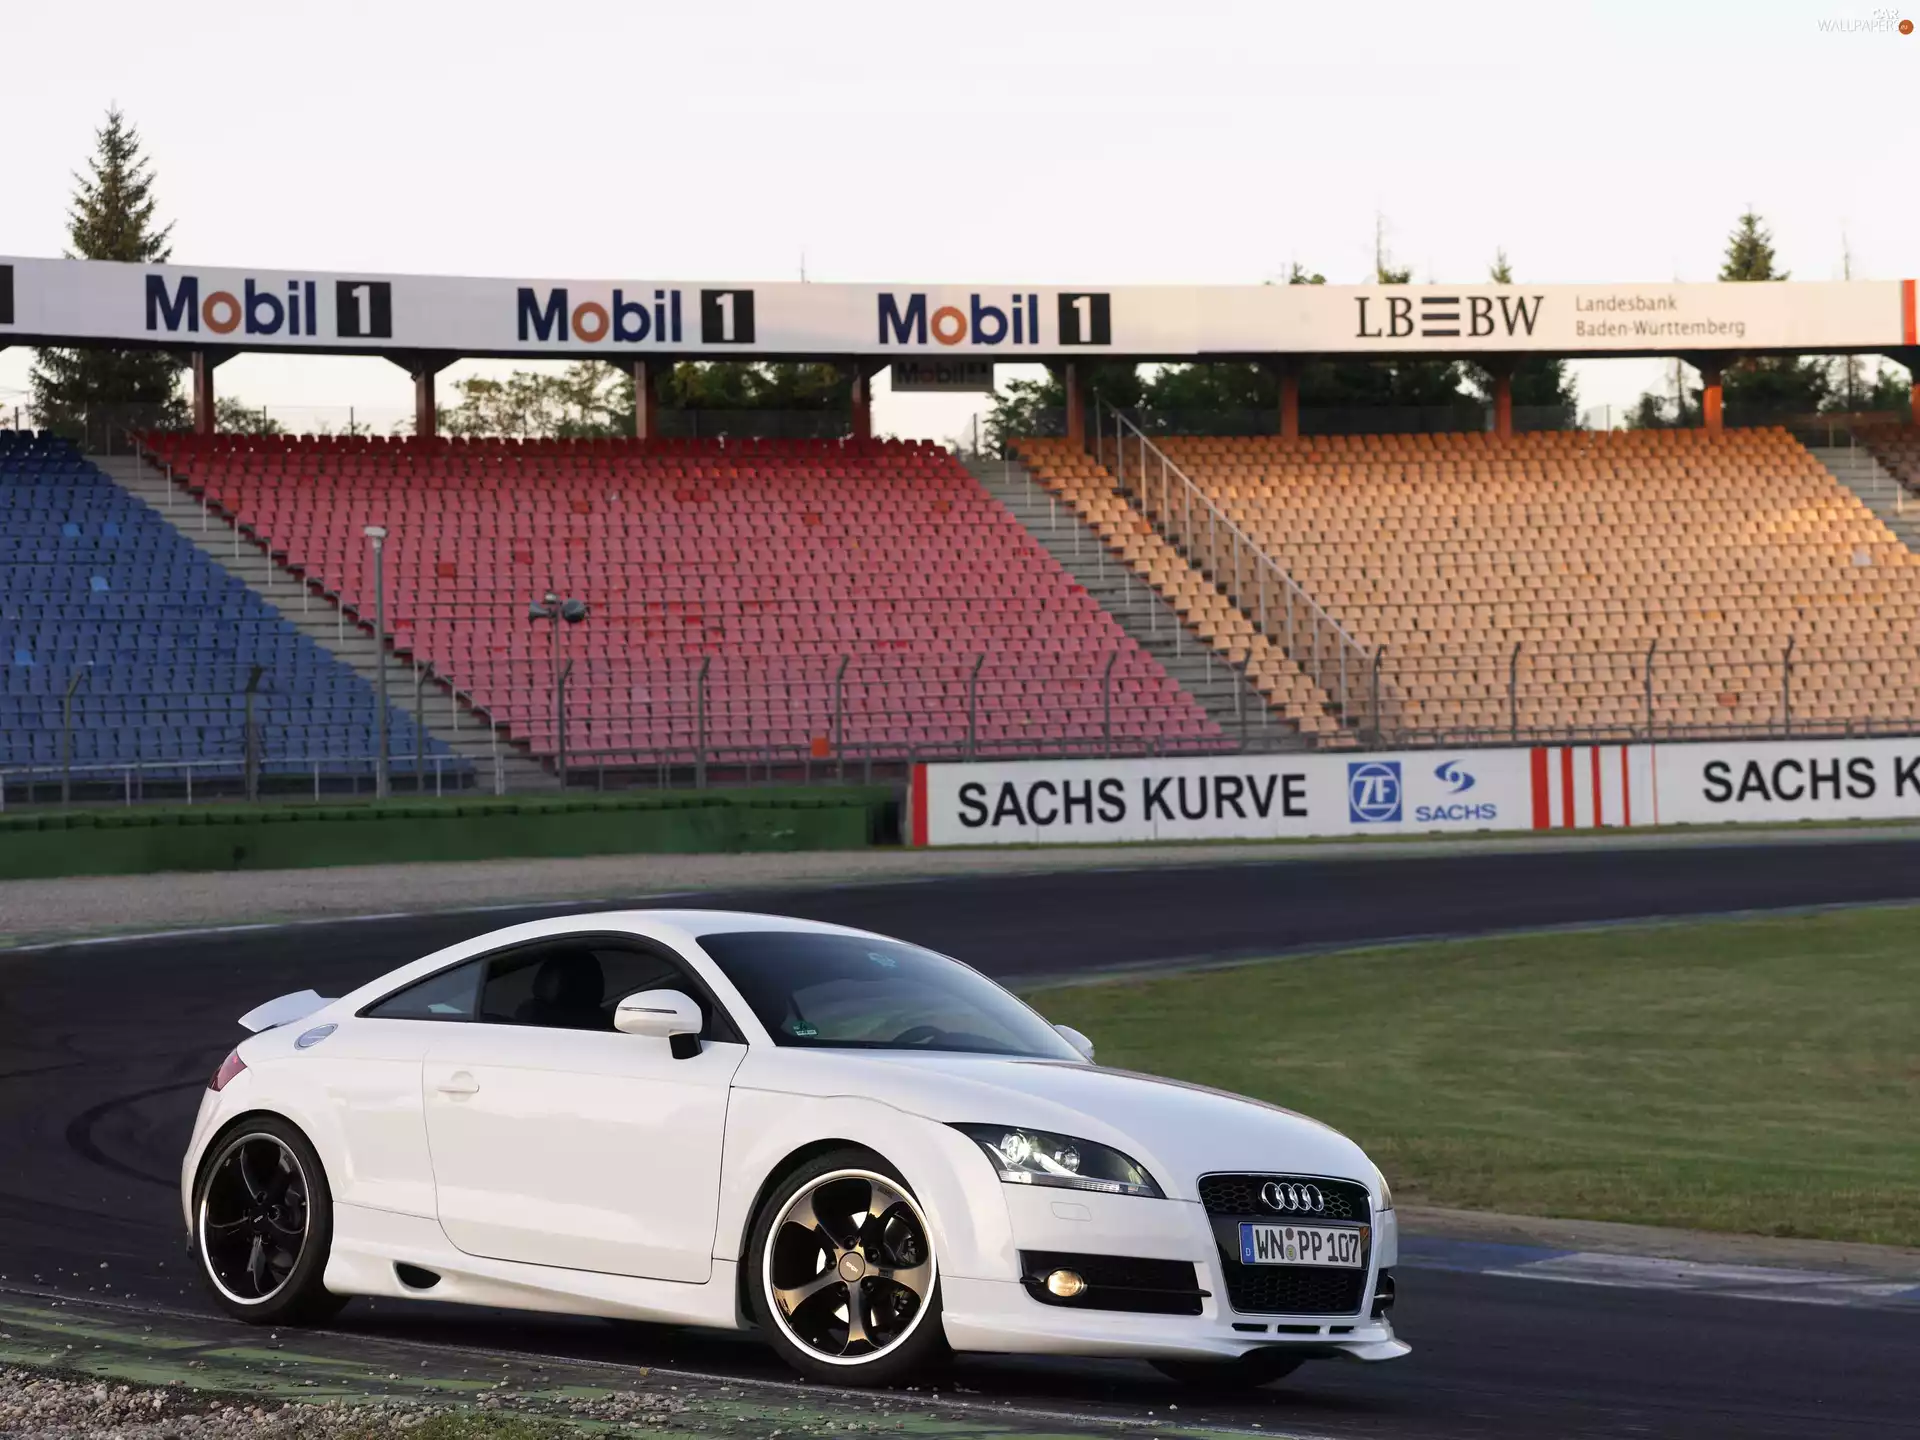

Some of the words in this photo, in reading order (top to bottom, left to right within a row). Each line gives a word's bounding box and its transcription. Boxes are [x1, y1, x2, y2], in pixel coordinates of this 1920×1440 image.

[146, 274, 317, 336] Mobil
[351, 285, 372, 334] 1
[517, 288, 683, 343] Mobil
[715, 293, 735, 341] 1
[878, 293, 1039, 345] Mobil
[1072, 296, 1092, 342] 1
[1575, 296, 1677, 312] Landesbank
[958, 777, 1127, 828] SACHS
[1143, 773, 1309, 822] KURVE
[1703, 757, 1876, 803] SACHS
[1415, 803, 1498, 822] SACHS
[1255, 1229, 1285, 1260] WN
[1297, 1230, 1323, 1261] PP
[1327, 1232, 1359, 1264] 107
